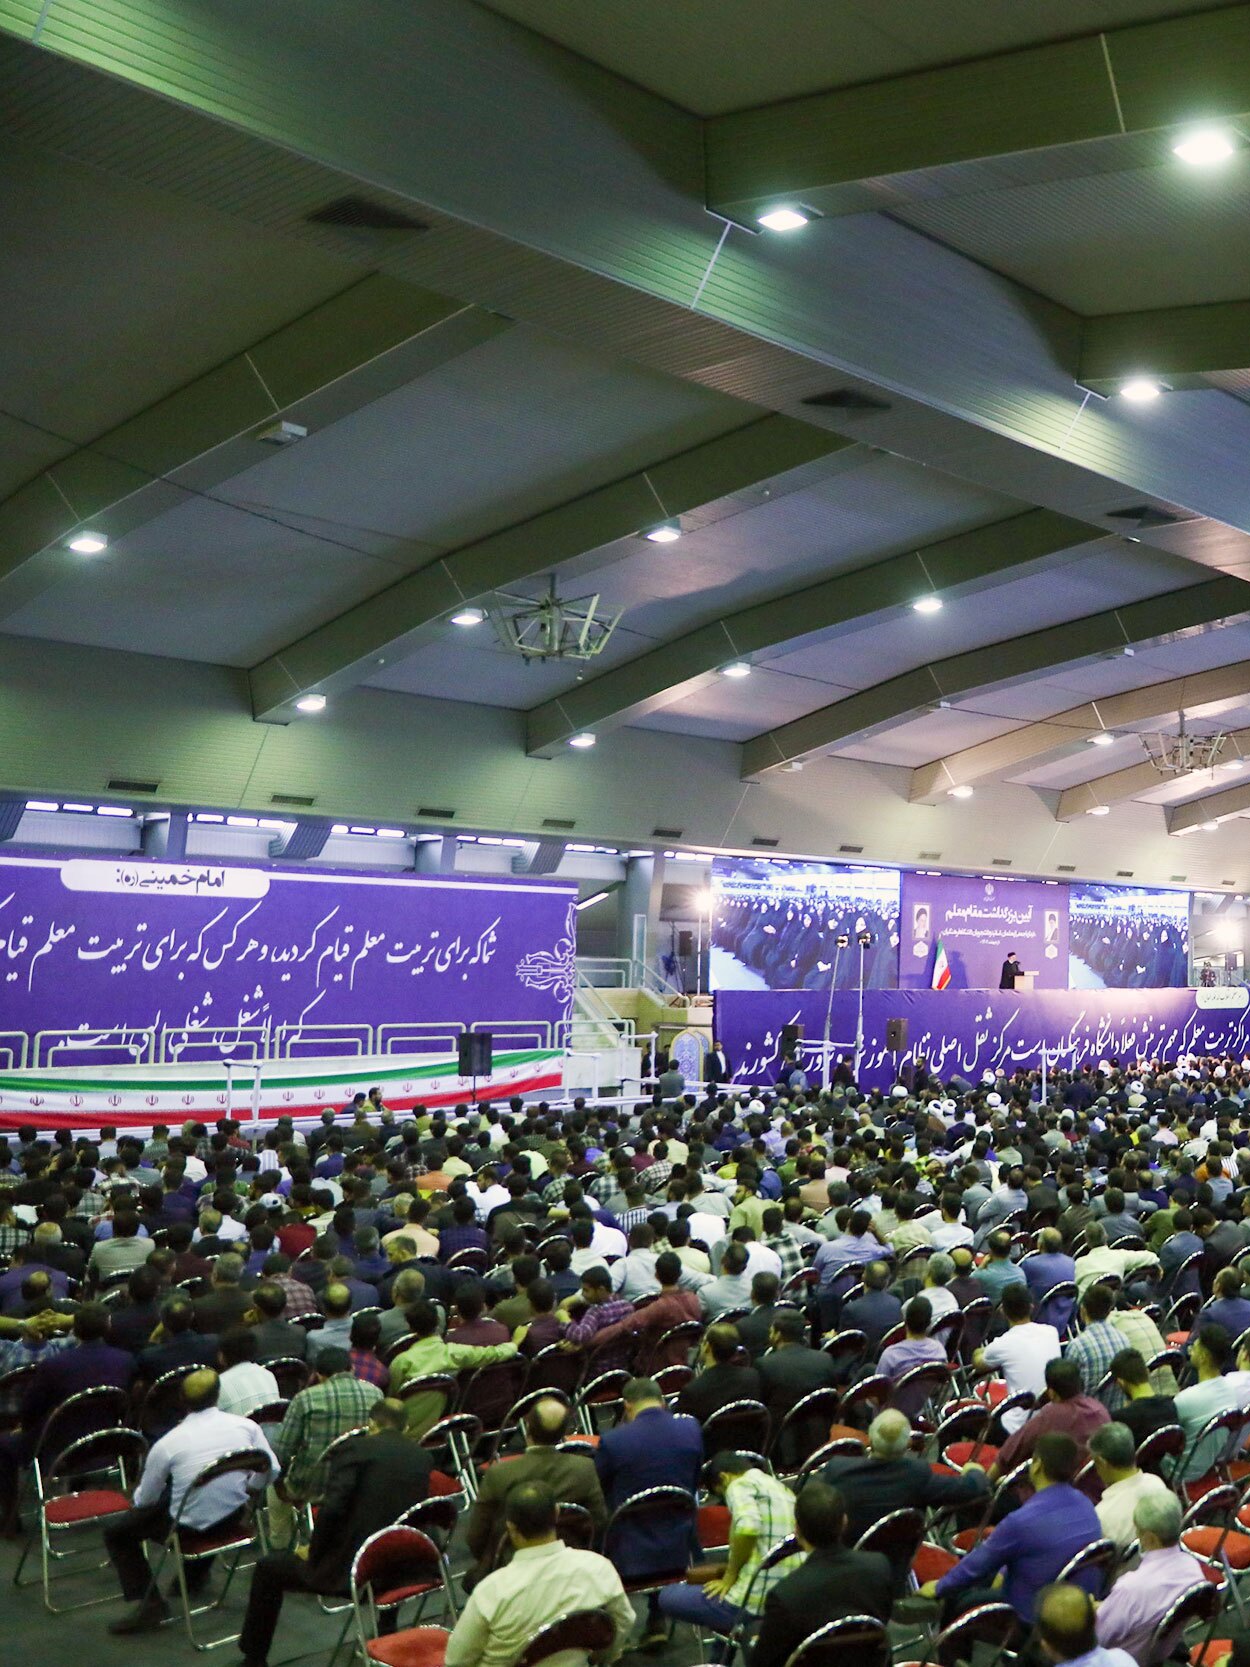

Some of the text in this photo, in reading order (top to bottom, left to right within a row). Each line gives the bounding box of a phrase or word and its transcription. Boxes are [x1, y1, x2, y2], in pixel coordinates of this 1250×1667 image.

[195, 868, 226, 894] امام
[186, 906, 229, 962] که
[202, 900, 263, 971] کس
[945, 903, 966, 922] معلم
[28, 920, 76, 992] معلم
[77, 922, 148, 975] تربیت
[141, 928, 189, 981] برای
[236, 938, 259, 962] هر
[257, 943, 268, 962] و
[316, 924, 354, 988] قیام
[350, 930, 386, 991] معلم
[385, 930, 440, 976] تربیت
[434, 935, 470, 981] برای
[930, 1035, 962, 1074] اصلی
[963, 1006, 993, 1073] ثقل
